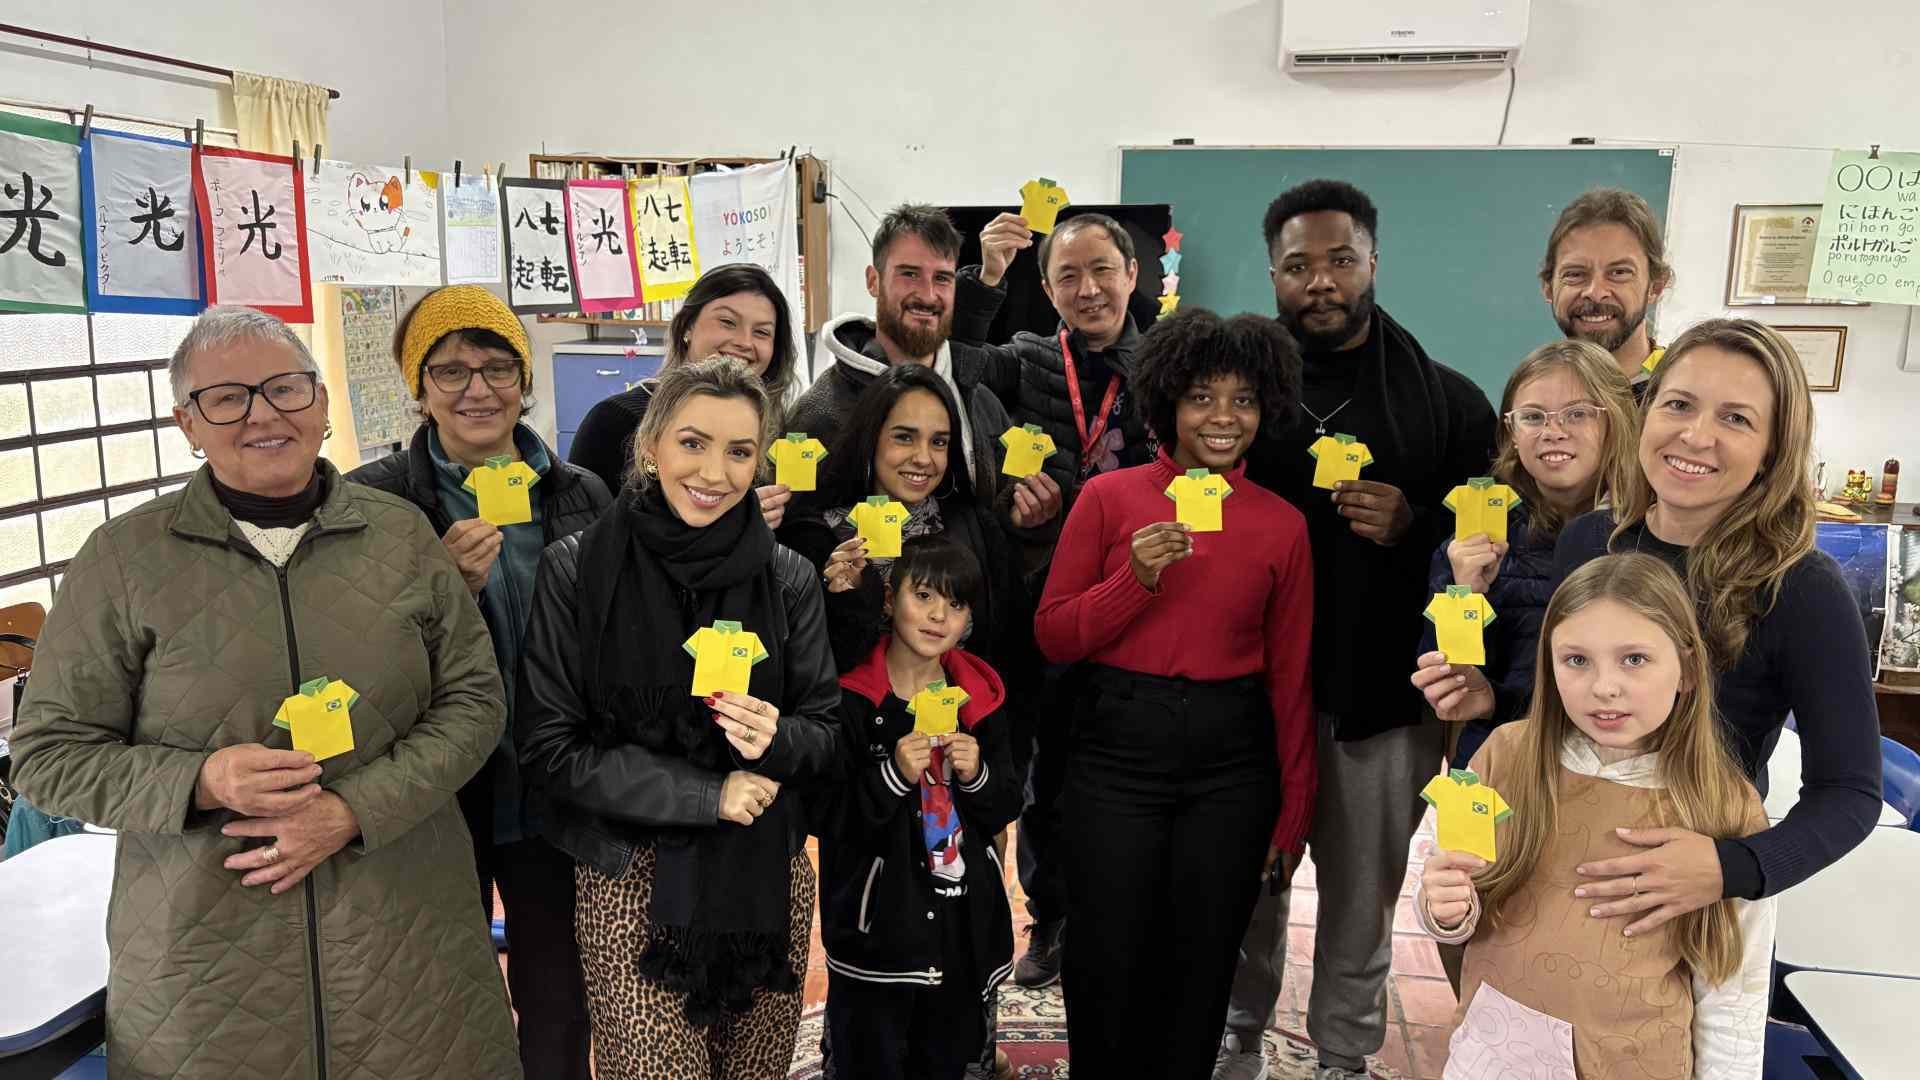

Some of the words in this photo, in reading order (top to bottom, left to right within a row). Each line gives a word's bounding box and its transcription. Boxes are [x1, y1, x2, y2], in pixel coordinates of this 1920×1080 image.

[0, 172, 66, 266] 光
[128, 187, 185, 251] 光
[237, 189, 282, 260] 光
[1839, 204, 1919, 220] にほんご
[1897, 191, 1917, 202] wa
[592, 207, 623, 255] 光
